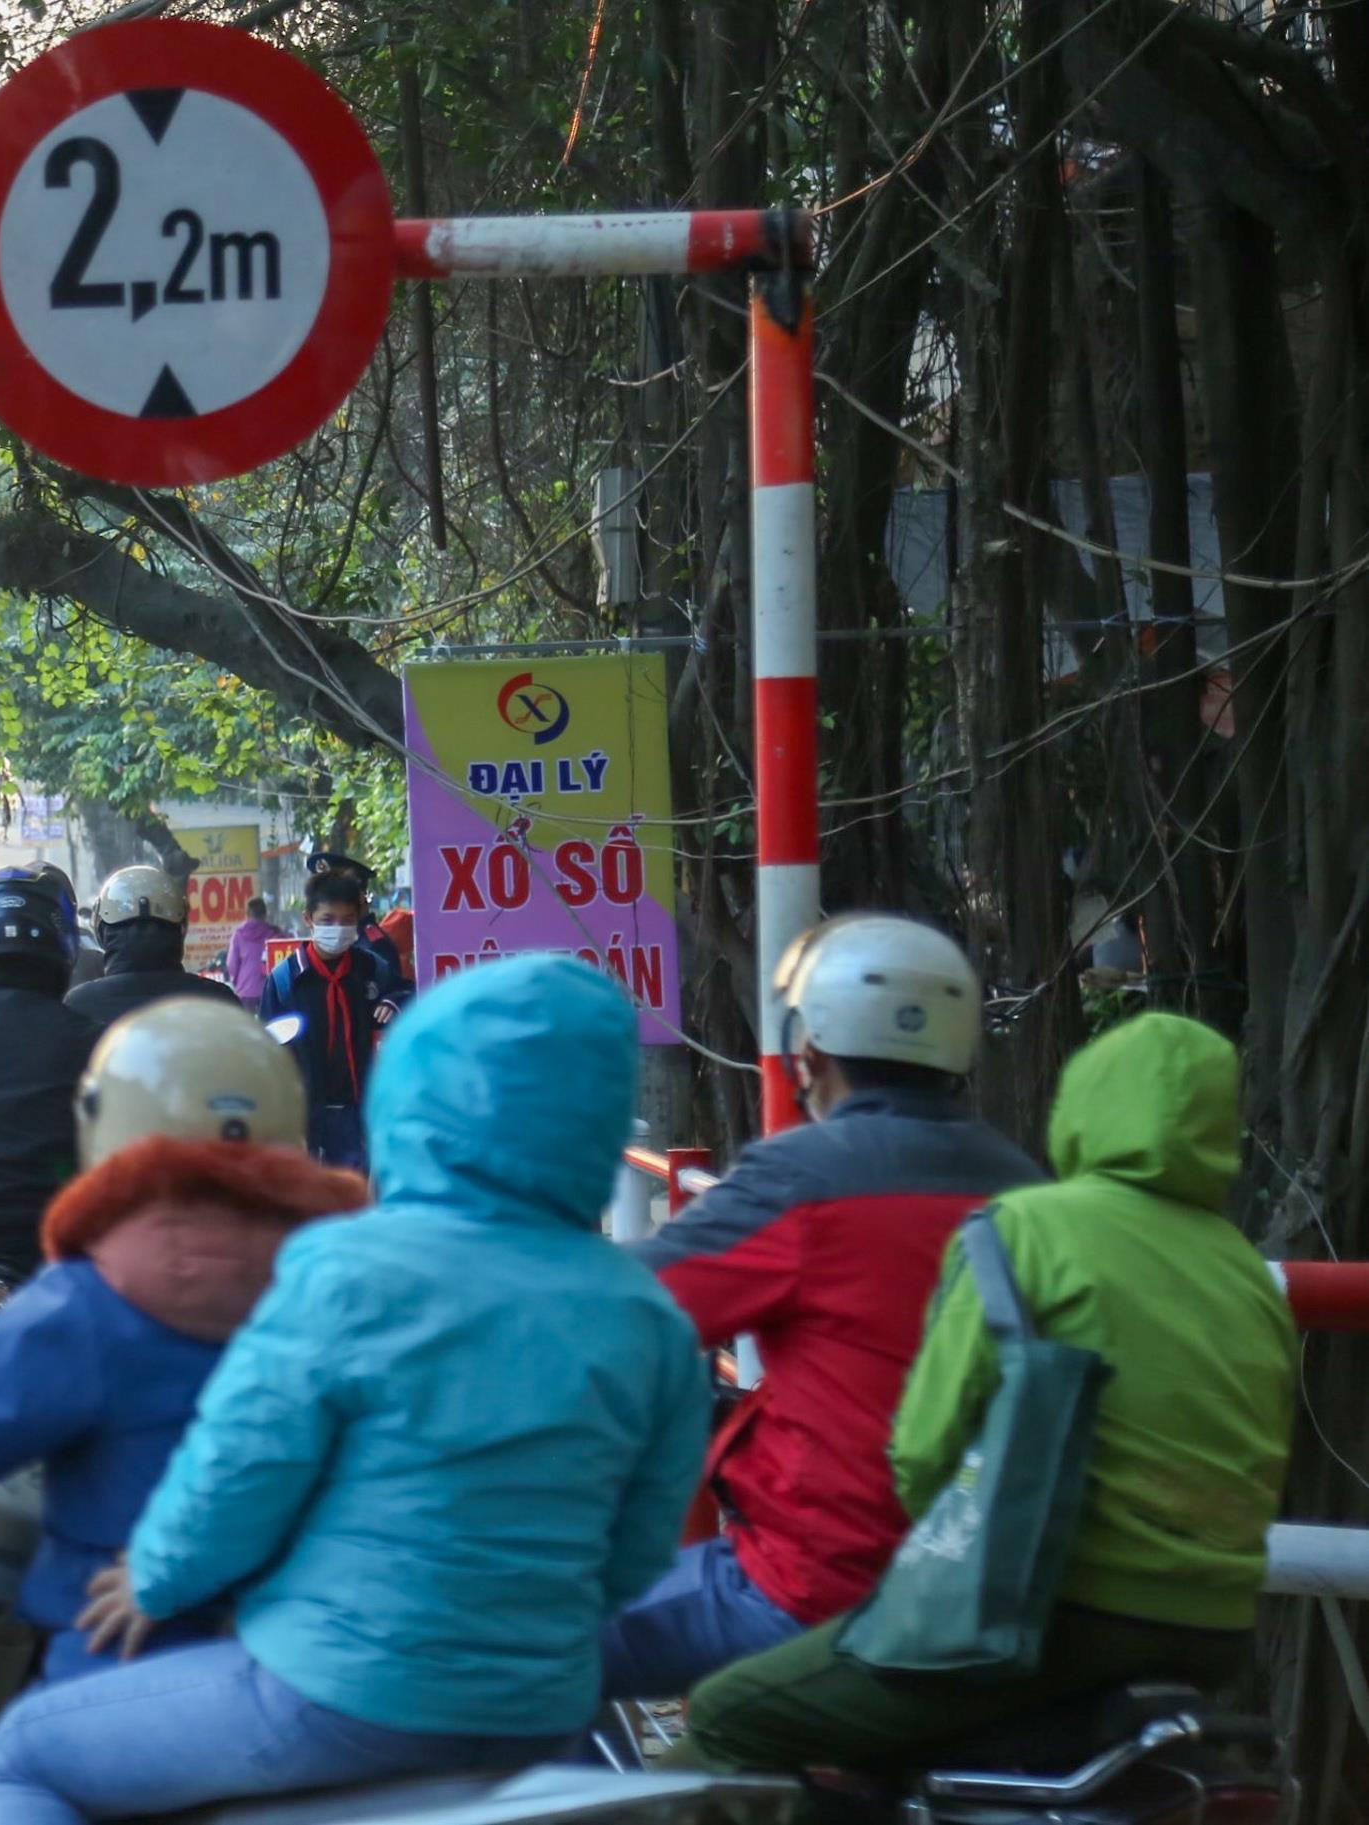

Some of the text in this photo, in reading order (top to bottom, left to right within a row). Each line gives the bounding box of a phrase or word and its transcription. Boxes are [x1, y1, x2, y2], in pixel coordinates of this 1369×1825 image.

[469, 752, 609, 803] ĐẠI LÝ
[552, 813, 645, 909] SỐ
